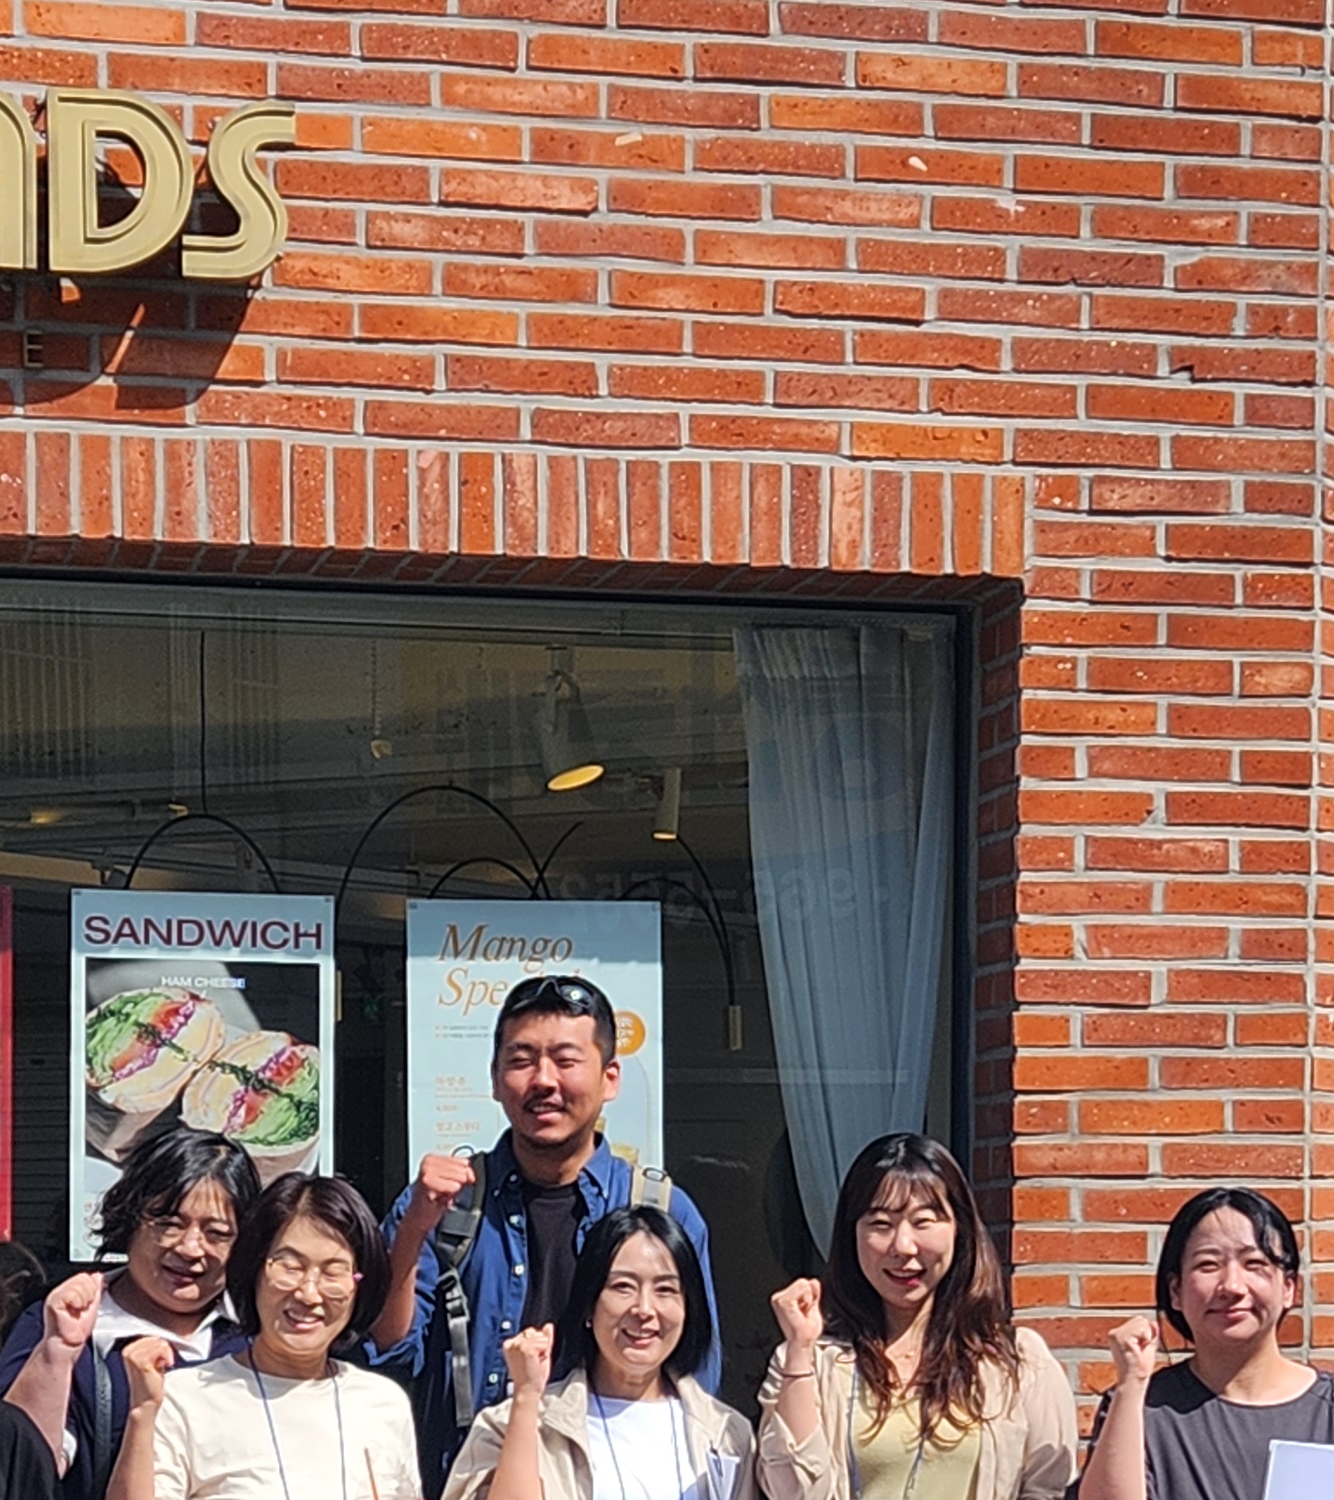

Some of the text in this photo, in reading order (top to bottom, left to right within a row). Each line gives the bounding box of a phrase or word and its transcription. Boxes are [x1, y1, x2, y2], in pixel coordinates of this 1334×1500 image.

[83, 915, 323, 951] SANDWICH
[438, 923, 574, 973] Mango
[161, 976, 192, 988] HAM
